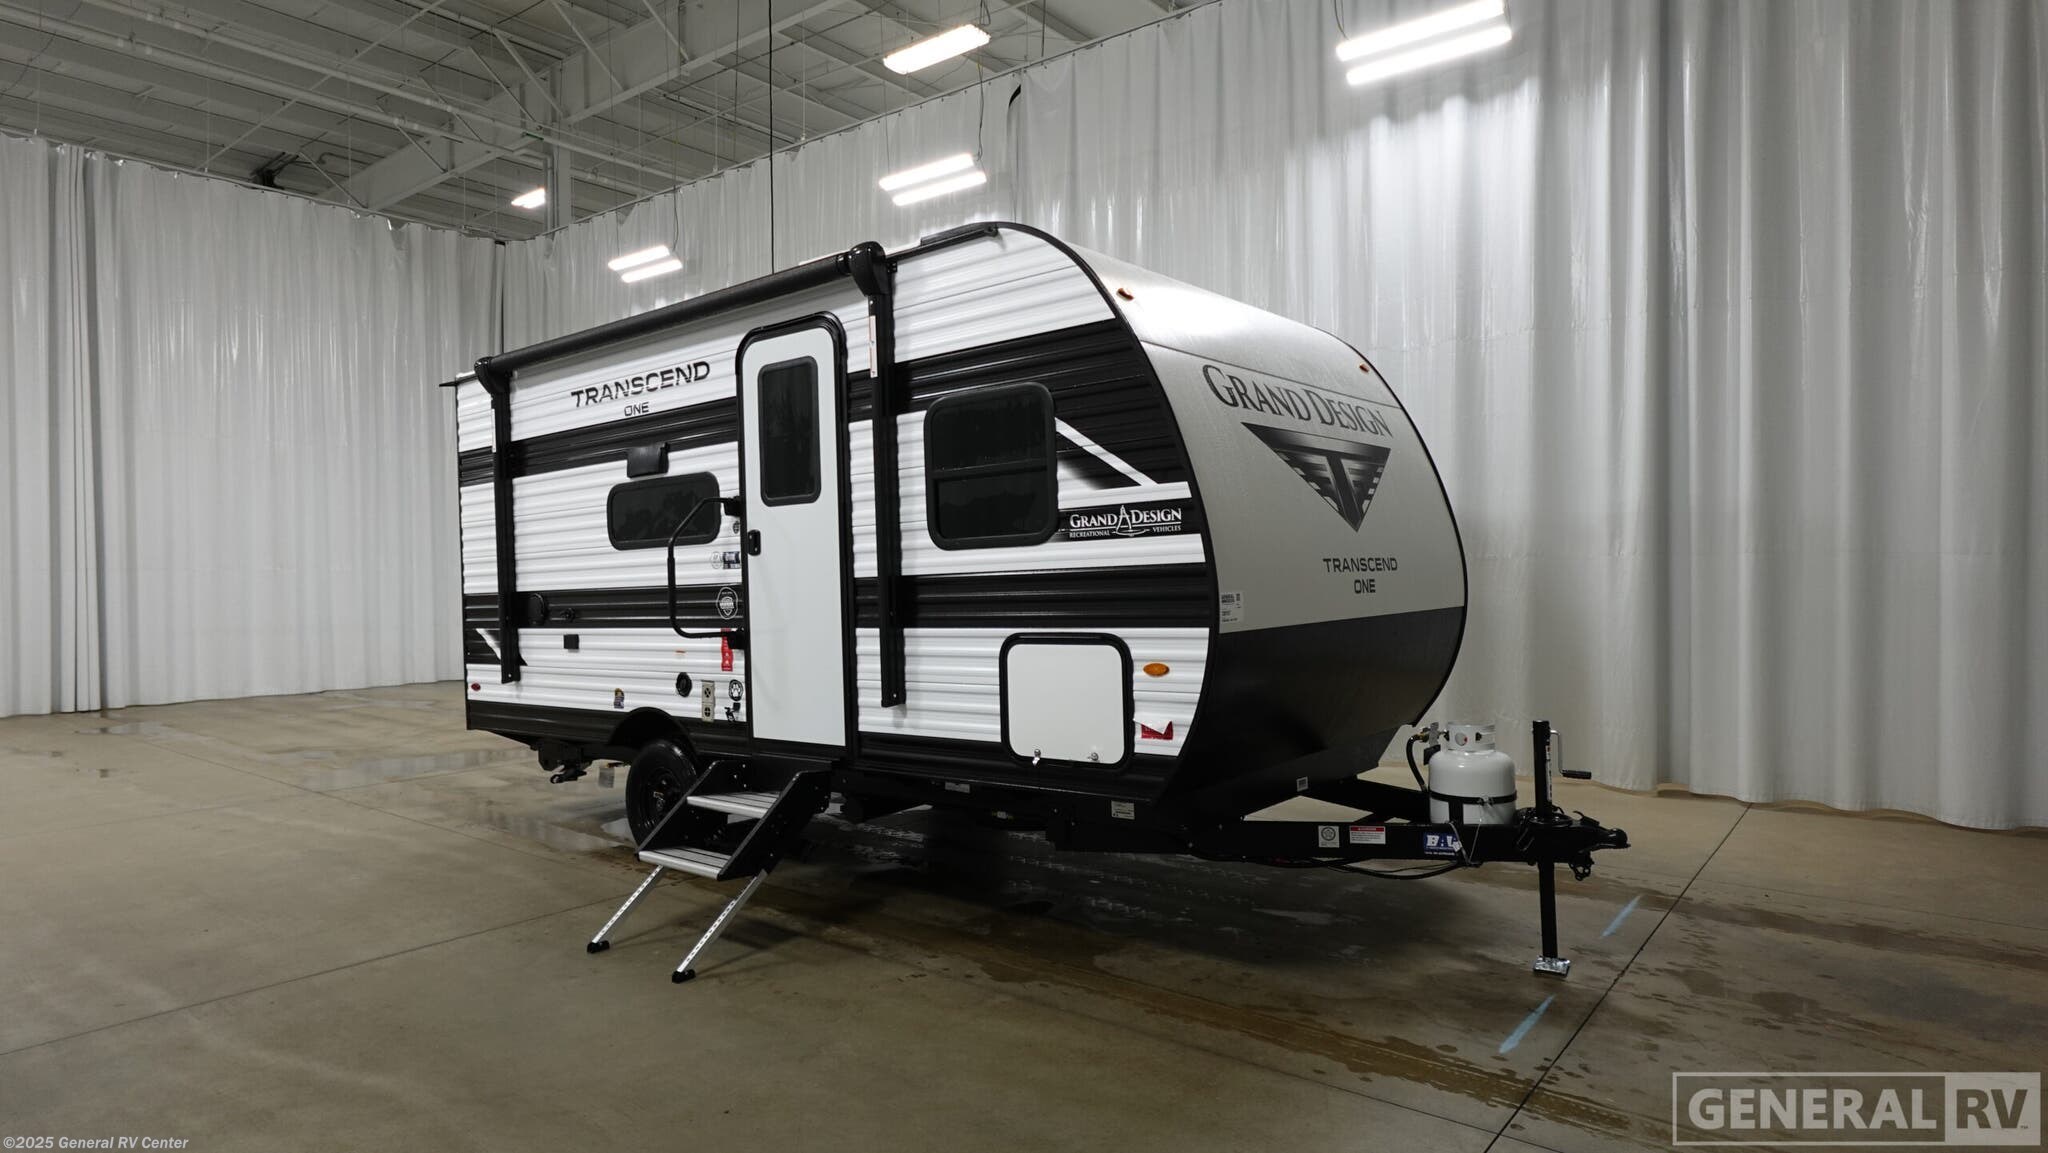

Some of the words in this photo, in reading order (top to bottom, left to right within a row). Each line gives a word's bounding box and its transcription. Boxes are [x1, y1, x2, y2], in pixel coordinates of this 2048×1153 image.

[571, 361, 711, 408] TRANSCEND
[623, 401, 650, 417] ONE
[1202, 364, 1312, 421] GRAND
[1303, 389, 1394, 438] DESIGN
[1069, 513, 1118, 528] GRAND
[1130, 508, 1182, 524] DESIGN
[1069, 529, 1111, 538] RECREATIONAL
[1152, 525, 1181, 533] VEHICLES
[1322, 556, 1398, 573] TRANSCEND
[1353, 578, 1376, 594] ONE
